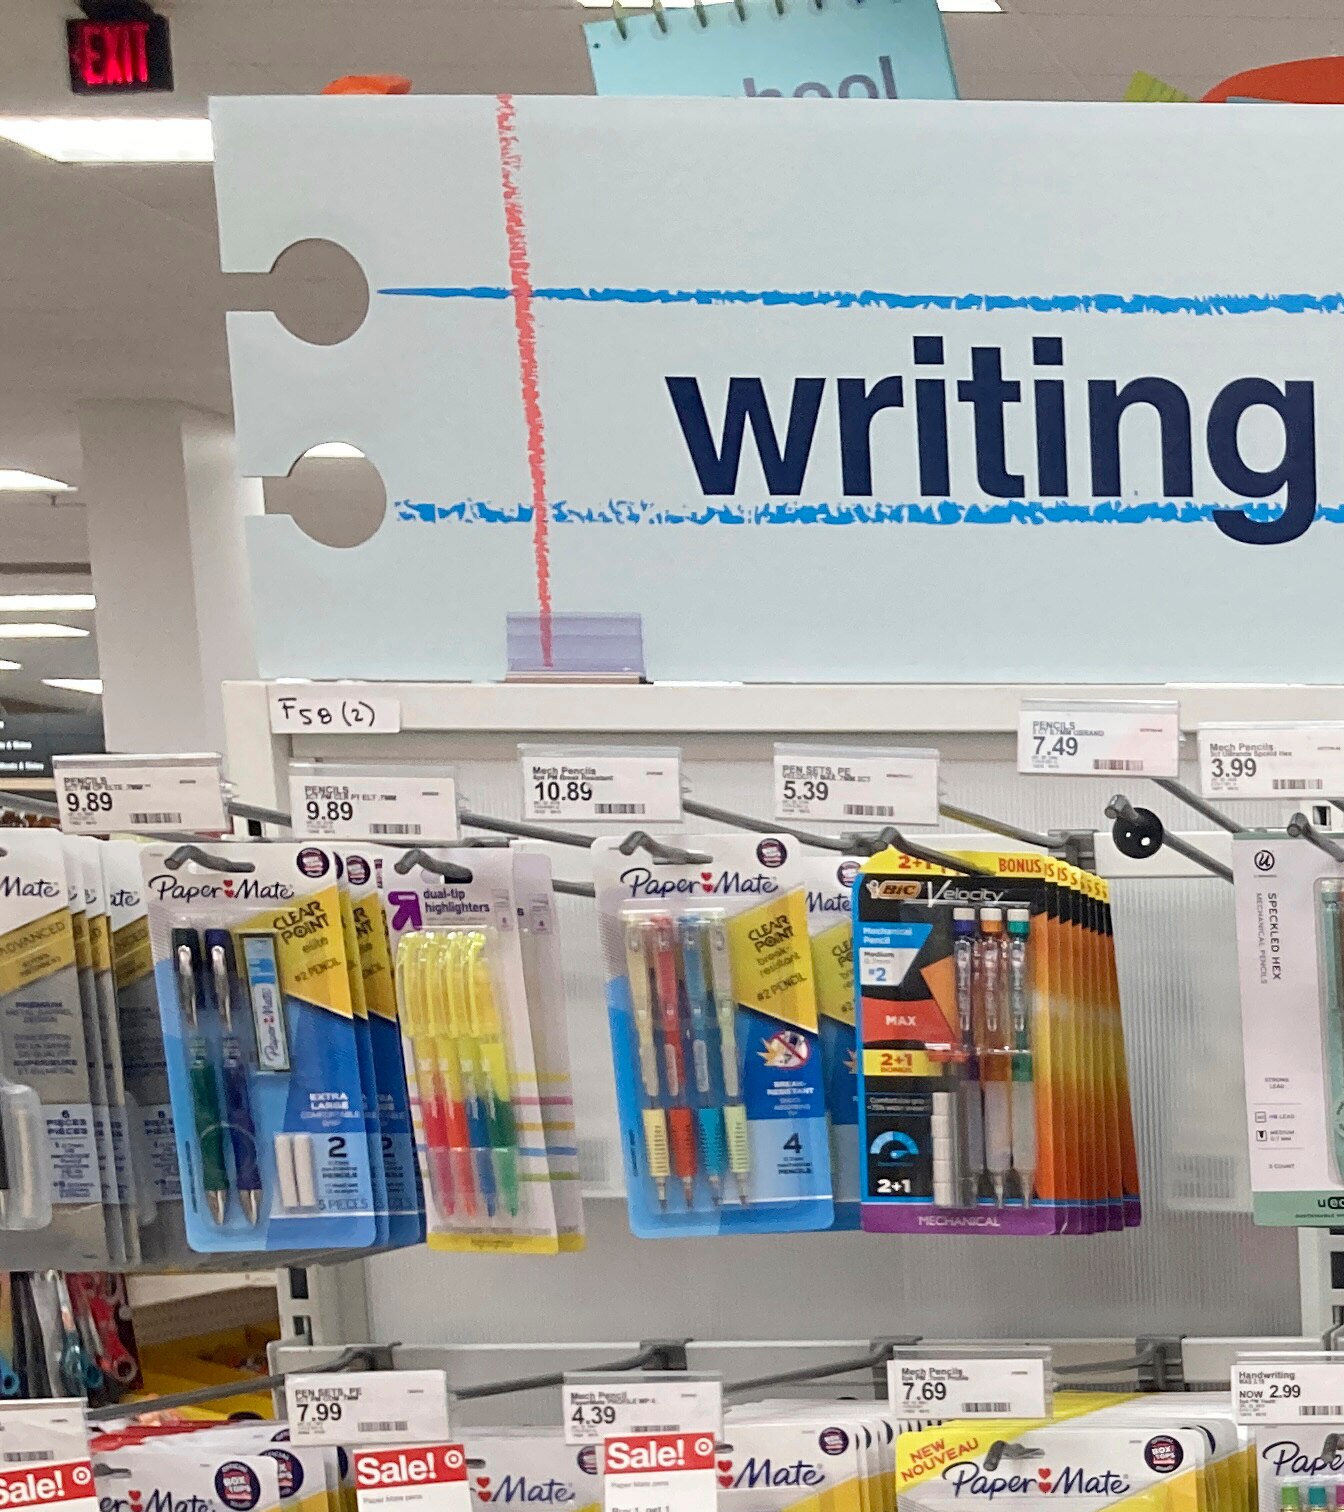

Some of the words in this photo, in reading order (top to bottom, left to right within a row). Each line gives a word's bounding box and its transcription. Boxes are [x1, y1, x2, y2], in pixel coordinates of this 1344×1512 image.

[82, 23, 149, 85] EXIT
[665, 337, 1315, 545] writing
[342, 699, 376, 728] (2)
[1033, 736, 1079, 756] 7.49
[1211, 758, 1257, 778] 3.99
[66, 792, 113, 812] 9.89
[534, 781, 593, 801] 10.89
[783, 780, 829, 801] 5.39
[306, 801, 354, 821] 9.89
[998, 856, 1042, 875] BONUS
[148, 874, 224, 904] Paper
[233, 878, 295, 900] Mate
[423, 888, 465, 901] dual-tip
[620, 867, 701, 899] Paper
[716, 873, 778, 896] Mate
[883, 882, 920, 898] BIC
[928, 879, 1006, 908] Velocity
[273, 900, 324, 931] CLEAR
[425, 902, 490, 914] highlighters
[280, 913, 330, 945] POINT
[885, 1014, 917, 1027] MAX
[327, 1136, 347, 1160] 2
[782, 1131, 803, 1154] 4
[877, 1177, 911, 1194] 2+1
[918, 1213, 1002, 1228] MECHANICAL
[902, 1381, 947, 1401] 7.69
[1239, 1389, 1264, 1400] NOW
[1269, 1383, 1301, 1401] 2.99
[296, 1403, 342, 1422] 7.99
[571, 1406, 616, 1425] 4.39
[606, 1441, 687, 1471] Sale!
[900, 1438, 979, 1483] NOUVEAU
[908, 1438, 946, 1463] NEW
[356, 1451, 437, 1486] Sale!
[734, 1458, 826, 1489] Mate
[492, 1475, 577, 1505] Mate
[942, 1460, 1038, 1501] Paper
[1049, 1465, 1131, 1495] Mate
